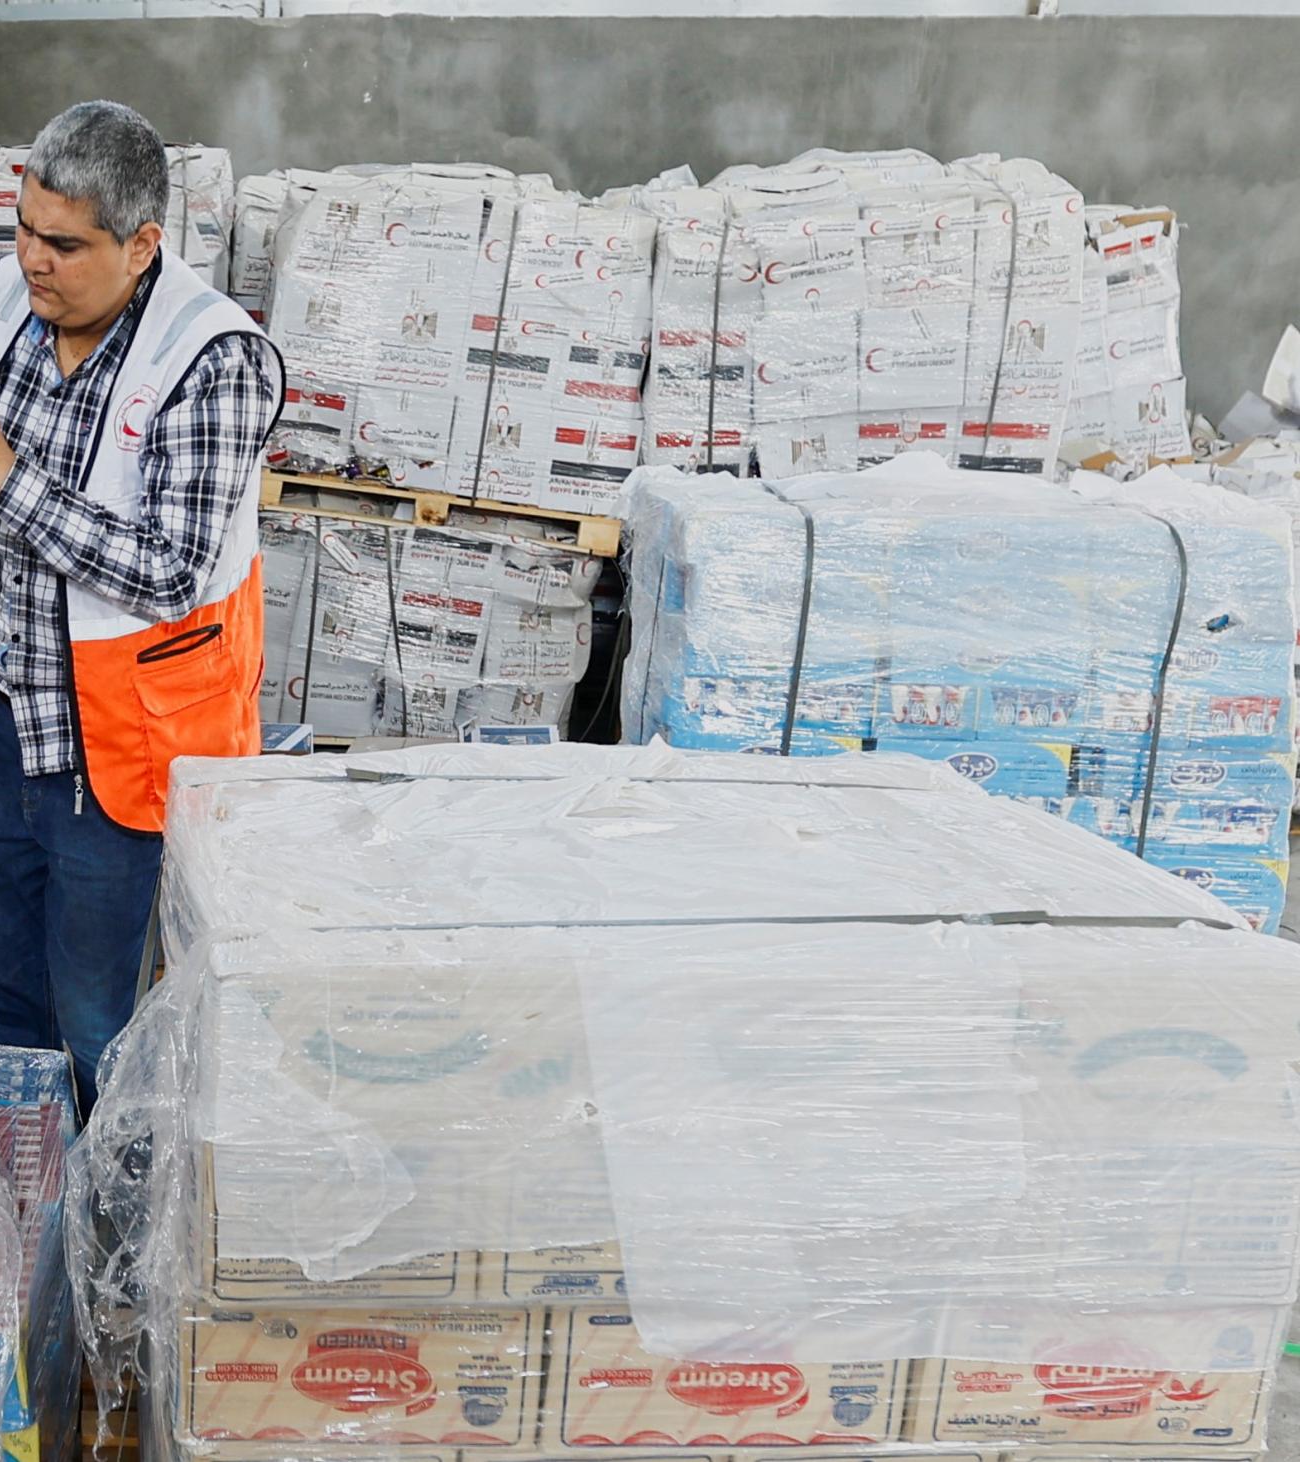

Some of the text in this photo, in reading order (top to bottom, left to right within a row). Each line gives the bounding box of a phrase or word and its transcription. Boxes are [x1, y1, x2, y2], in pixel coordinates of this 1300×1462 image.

[550, 485, 572, 494] EGYPT
[411, 551, 433, 561] EGYPT
[432, 1321, 464, 1333] MEAT
[468, 1321, 503, 1333] LIGHT
[216, 1363, 277, 1372] DARK COLOR
[206, 1372, 277, 1381] SECOND CLASS
[626, 1369, 652, 1378] DARK
[304, 1367, 417, 1394] Stream
[613, 1377, 652, 1387] SECOND
[679, 1370, 792, 1395] Stream
